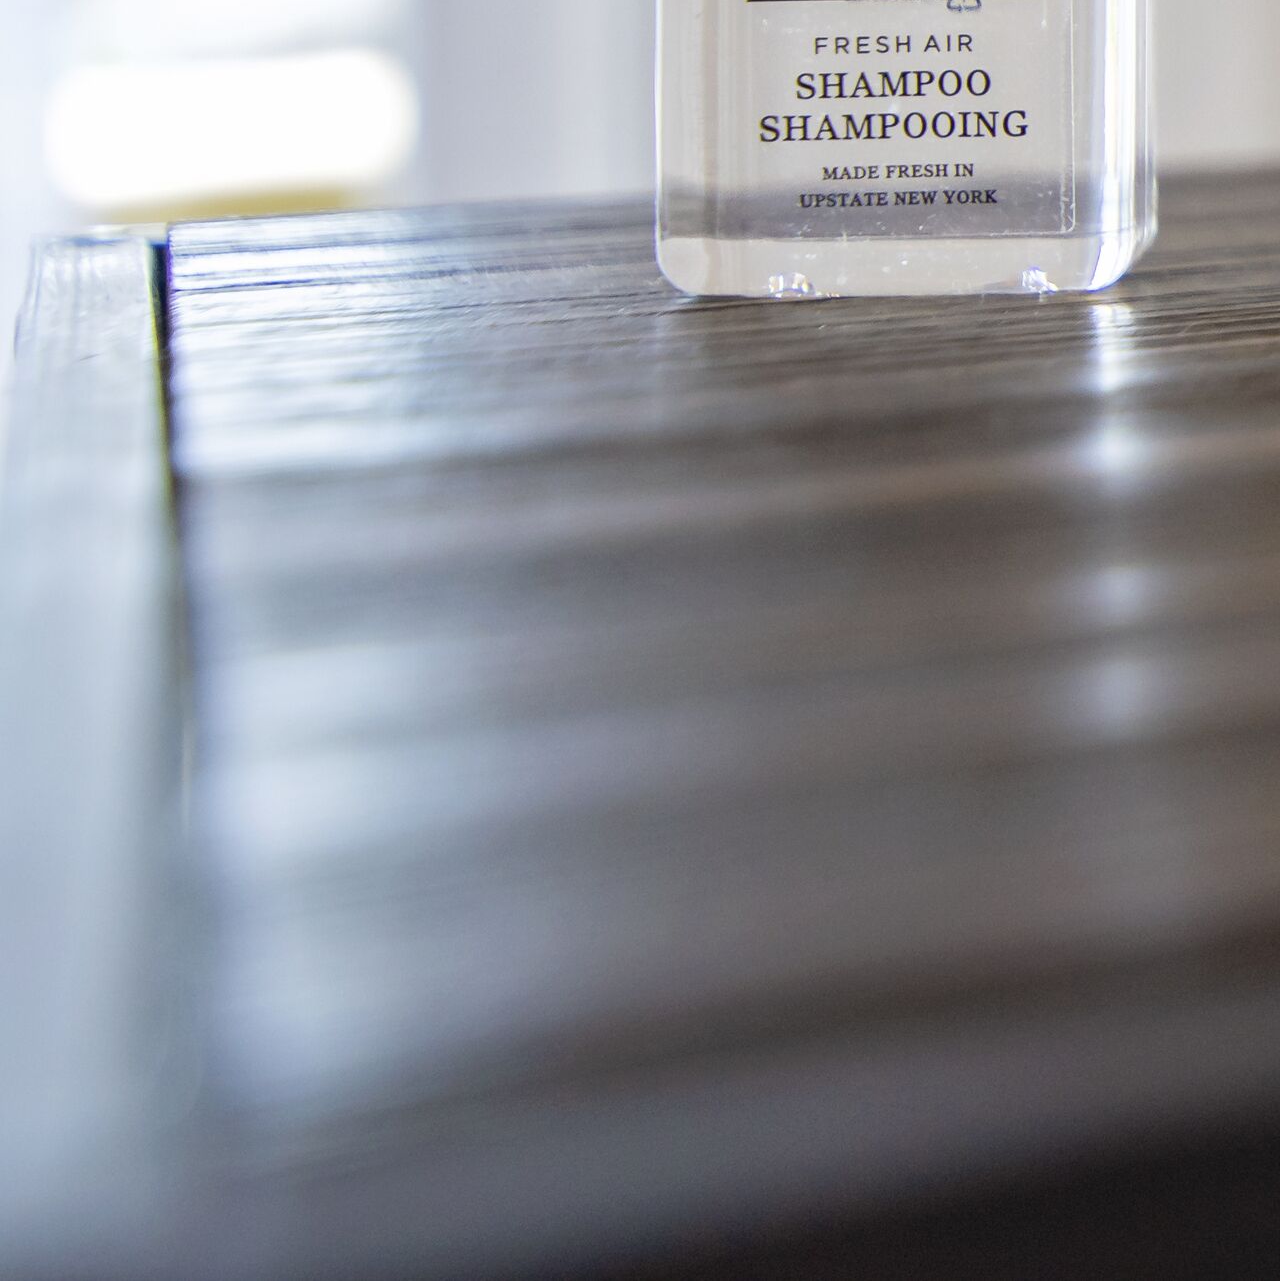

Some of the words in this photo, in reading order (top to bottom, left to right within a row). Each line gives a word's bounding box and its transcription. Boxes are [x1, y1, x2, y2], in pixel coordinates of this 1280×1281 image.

[814, 35, 911, 55] FRESH
[923, 34, 973, 53] AIR
[796, 69, 991, 100] SHAMPOO
[759, 110, 1028, 143] SHAMPOOING
[822, 165, 880, 181] MADE
[885, 163, 949, 179] FRESH
[954, 163, 974, 178] IN
[799, 191, 889, 209] UPSTATE
[894, 190, 938, 207] NEW
[942, 189, 998, 205] YORK
